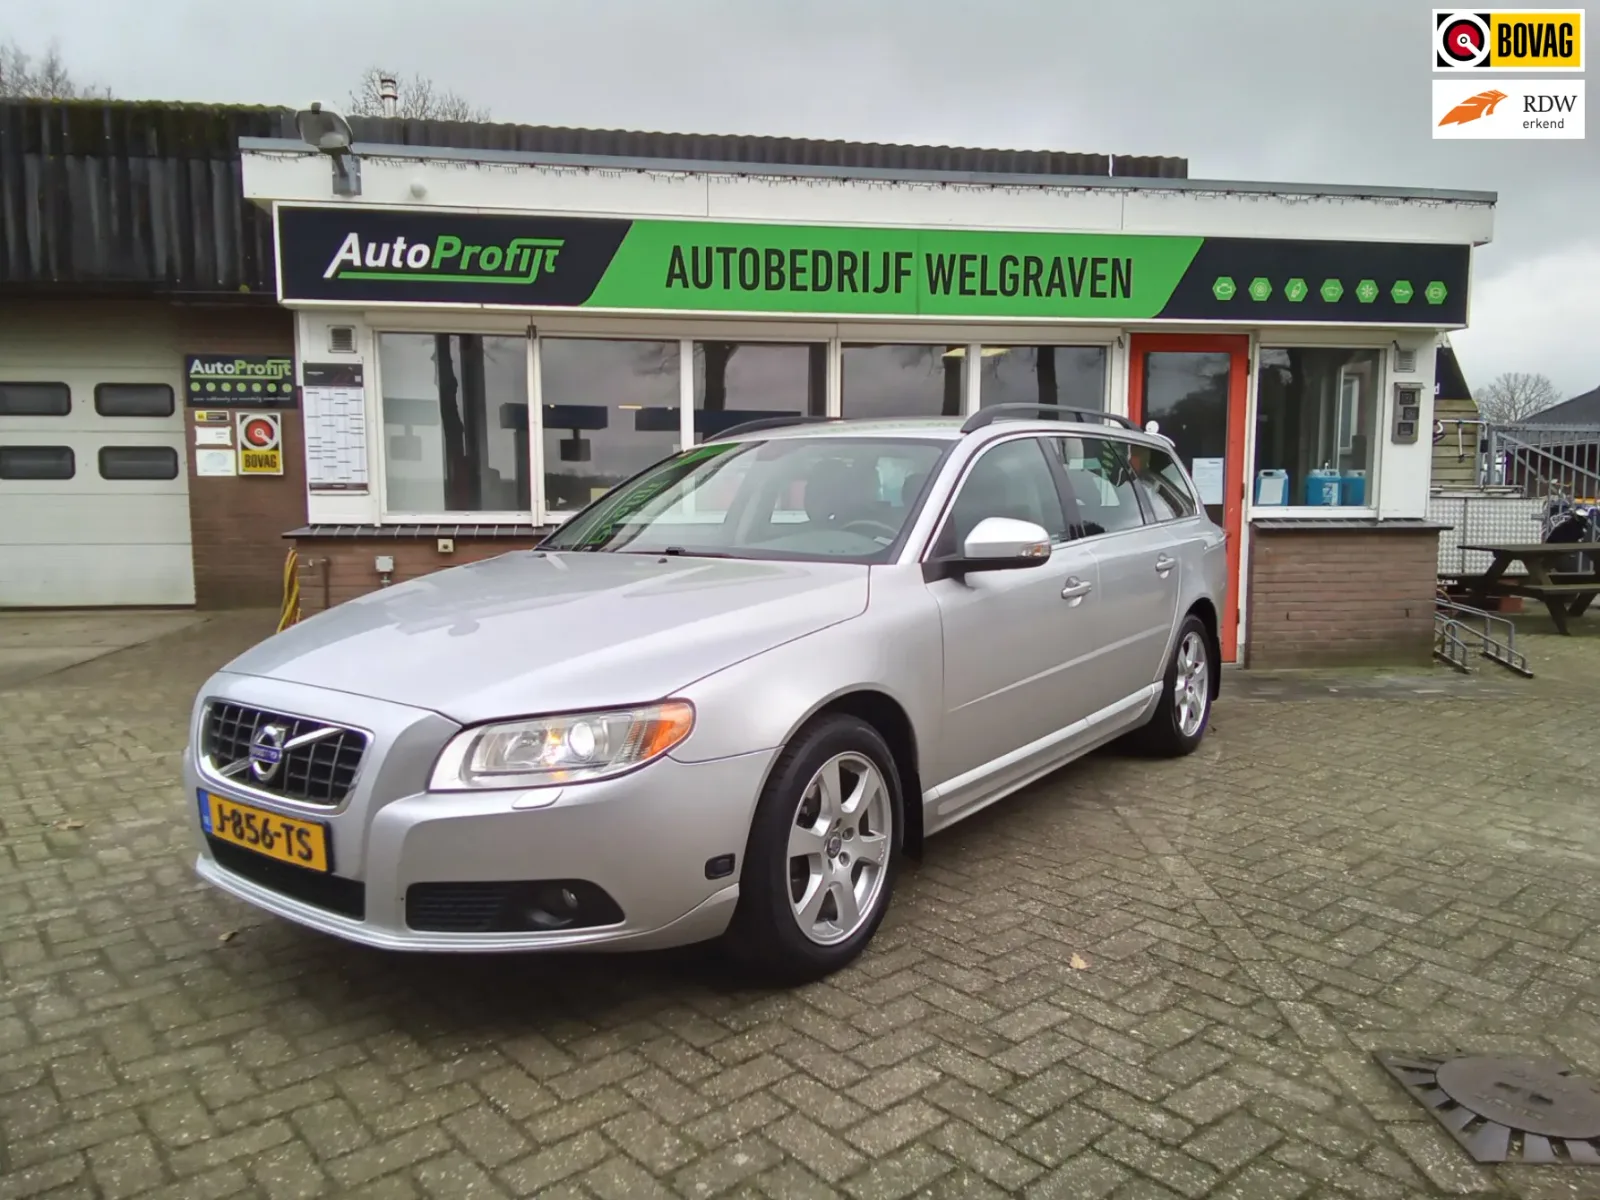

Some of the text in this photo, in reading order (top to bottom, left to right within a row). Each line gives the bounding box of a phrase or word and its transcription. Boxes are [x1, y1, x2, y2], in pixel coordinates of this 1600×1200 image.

[323, 232, 565, 284] AutoProfijt
[665, 245, 1133, 299] AUTOBEDRIJF WELGRAVEN
[244, 454, 277, 468] BOVAG
[216, 803, 313, 862] J-856-TS
